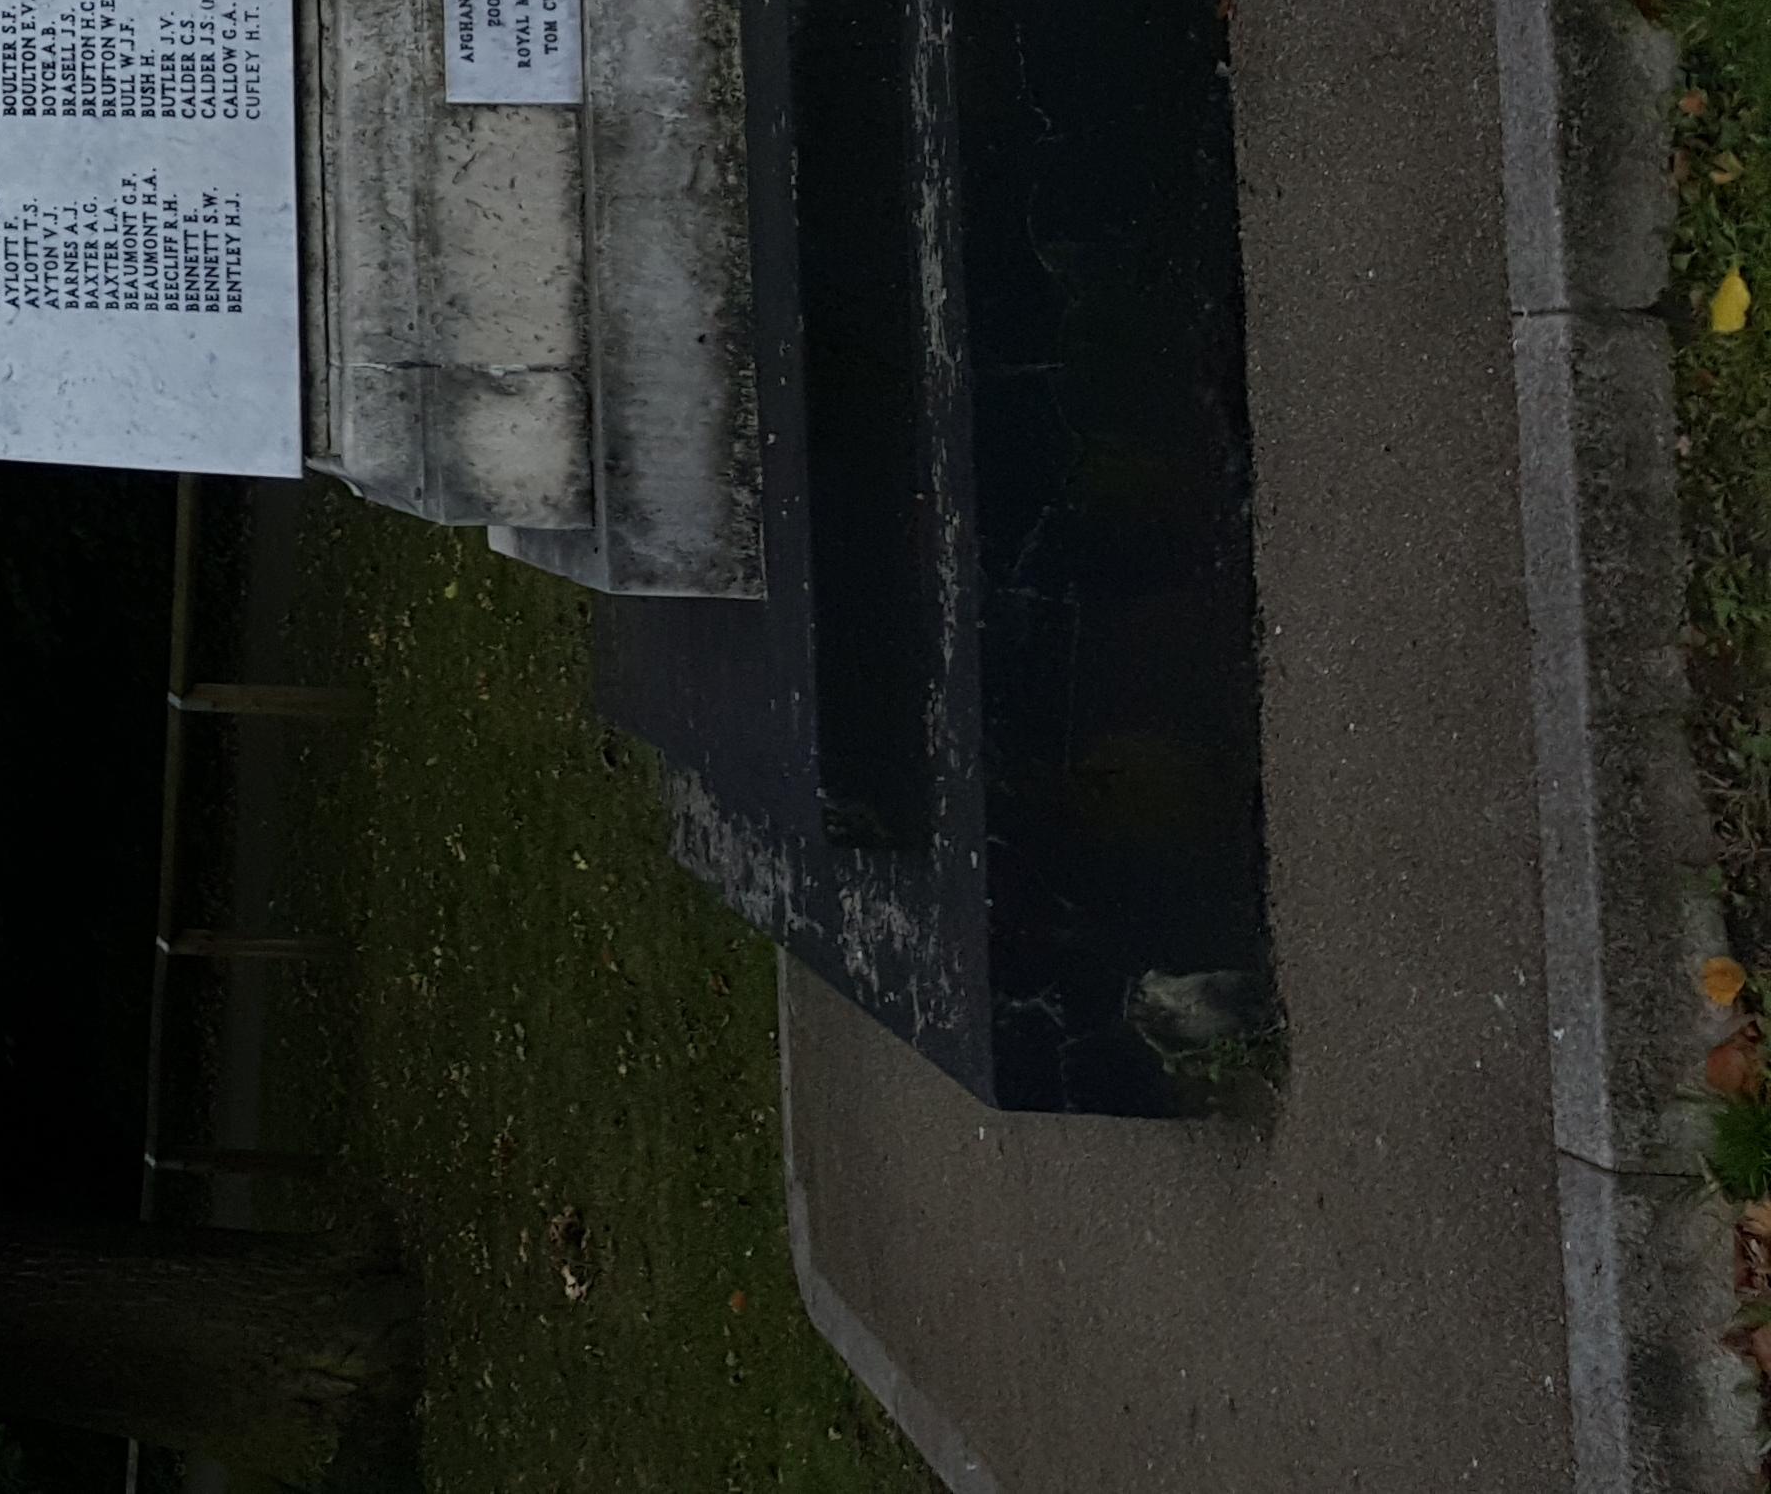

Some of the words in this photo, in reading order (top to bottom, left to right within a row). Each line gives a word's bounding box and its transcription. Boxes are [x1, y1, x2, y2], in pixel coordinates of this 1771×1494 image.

[1, 6, 17, 34] S.F.
[41, 21, 57, 56] A.B.
[60, 8, 75, 37] J.S.
[120, 18, 135, 69] W.J.F.
[160, 11, 175, 45] J.V.
[221, 2, 237, 40] G.A.
[244, 7, 260, 40] H.T.
[516, 15, 531, 68] ROYAL
[544, 21, 558, 55] TOM
[2, 41, 17, 116] BOULTER
[21, 37, 36, 117] BOULTON
[61, 43, 77, 117] BRASELL
[81, 36, 98, 119] BRUFTON
[101, 37, 116, 117] BRUFTON
[140, 49, 155, 66] H.
[222, 46, 238, 119] CALLOW
[42, 61, 57, 117] BOYCE
[120, 75, 136, 117] BULL
[140, 74, 156, 118] BUSH
[161, 52, 176, 118] BUTLER
[181, 52, 196, 119] CALDER
[201, 52, 216, 119] CALDER
[245, 50, 261, 120] CUFLEY
[122, 173, 137, 205] G.F.
[142, 168, 157, 206] H.A.
[163, 194, 178, 230] R.H.
[202, 187, 219, 224] S.W.
[225, 193, 241, 227] H.J.
[4, 216, 18, 230] F.
[23, 198, 38, 231] T.S.
[43, 207, 58, 240] V.J.
[63, 202, 78, 235] A.J.
[83, 197, 98, 234] A.G.
[103, 199, 118, 233] L.A.
[183, 209, 198, 223] E.
[4, 237, 20, 310] AYLOTT
[23, 236, 40, 309] AYLOTT
[43, 246, 60, 310] AYTON
[64, 241, 79, 309] BARNES
[84, 240, 99, 310] BAXTER
[104, 241, 119, 310] BAXTER
[122, 211, 139, 310] BEAUMONT
[142, 211, 159, 311] BEAUMONT
[164, 236, 179, 311] BEECLIFF
[183, 229, 200, 312] BENNETT
[203, 230, 220, 313] BENNETT
[225, 233, 242, 313] BENTLEY
